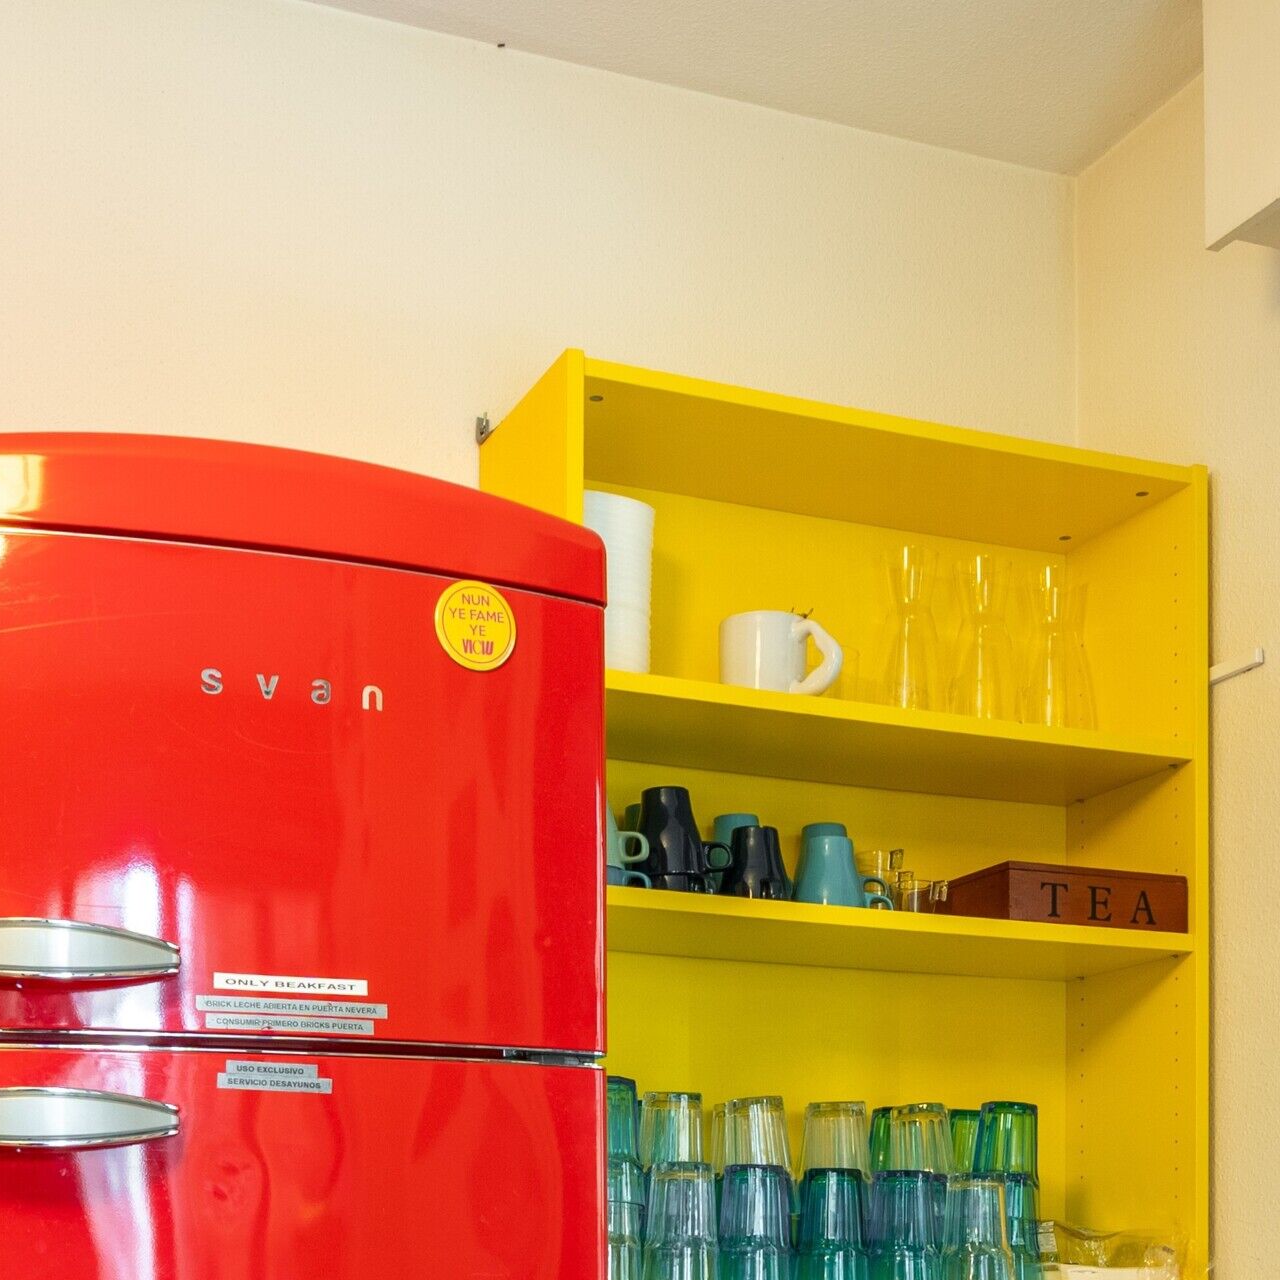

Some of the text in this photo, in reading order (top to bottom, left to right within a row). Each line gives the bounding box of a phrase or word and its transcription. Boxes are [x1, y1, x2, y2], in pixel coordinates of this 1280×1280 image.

[461, 594, 490, 606] NUN
[449, 607, 504, 624] YE FAME
[470, 624, 487, 637] YE
[200, 667, 384, 712] svan
[1040, 881, 1157, 926] TEA
[225, 978, 357, 991] ONLY BEAKFAST
[206, 1000, 232, 1008] BRICK
[233, 1001, 261, 1009] LECHE
[263, 1002, 297, 1011] ABIERTA
[312, 1004, 344, 1013] PUERTA
[345, 1006, 377, 1015] NEVERA
[216, 1017, 364, 1031] CONSUMIR PRIMERO BRICKS PUERTA
[236, 1064, 304, 1076] USO EXCLUSIVO
[227, 1078, 322, 1089] SERVICIO DESAYUNOS
